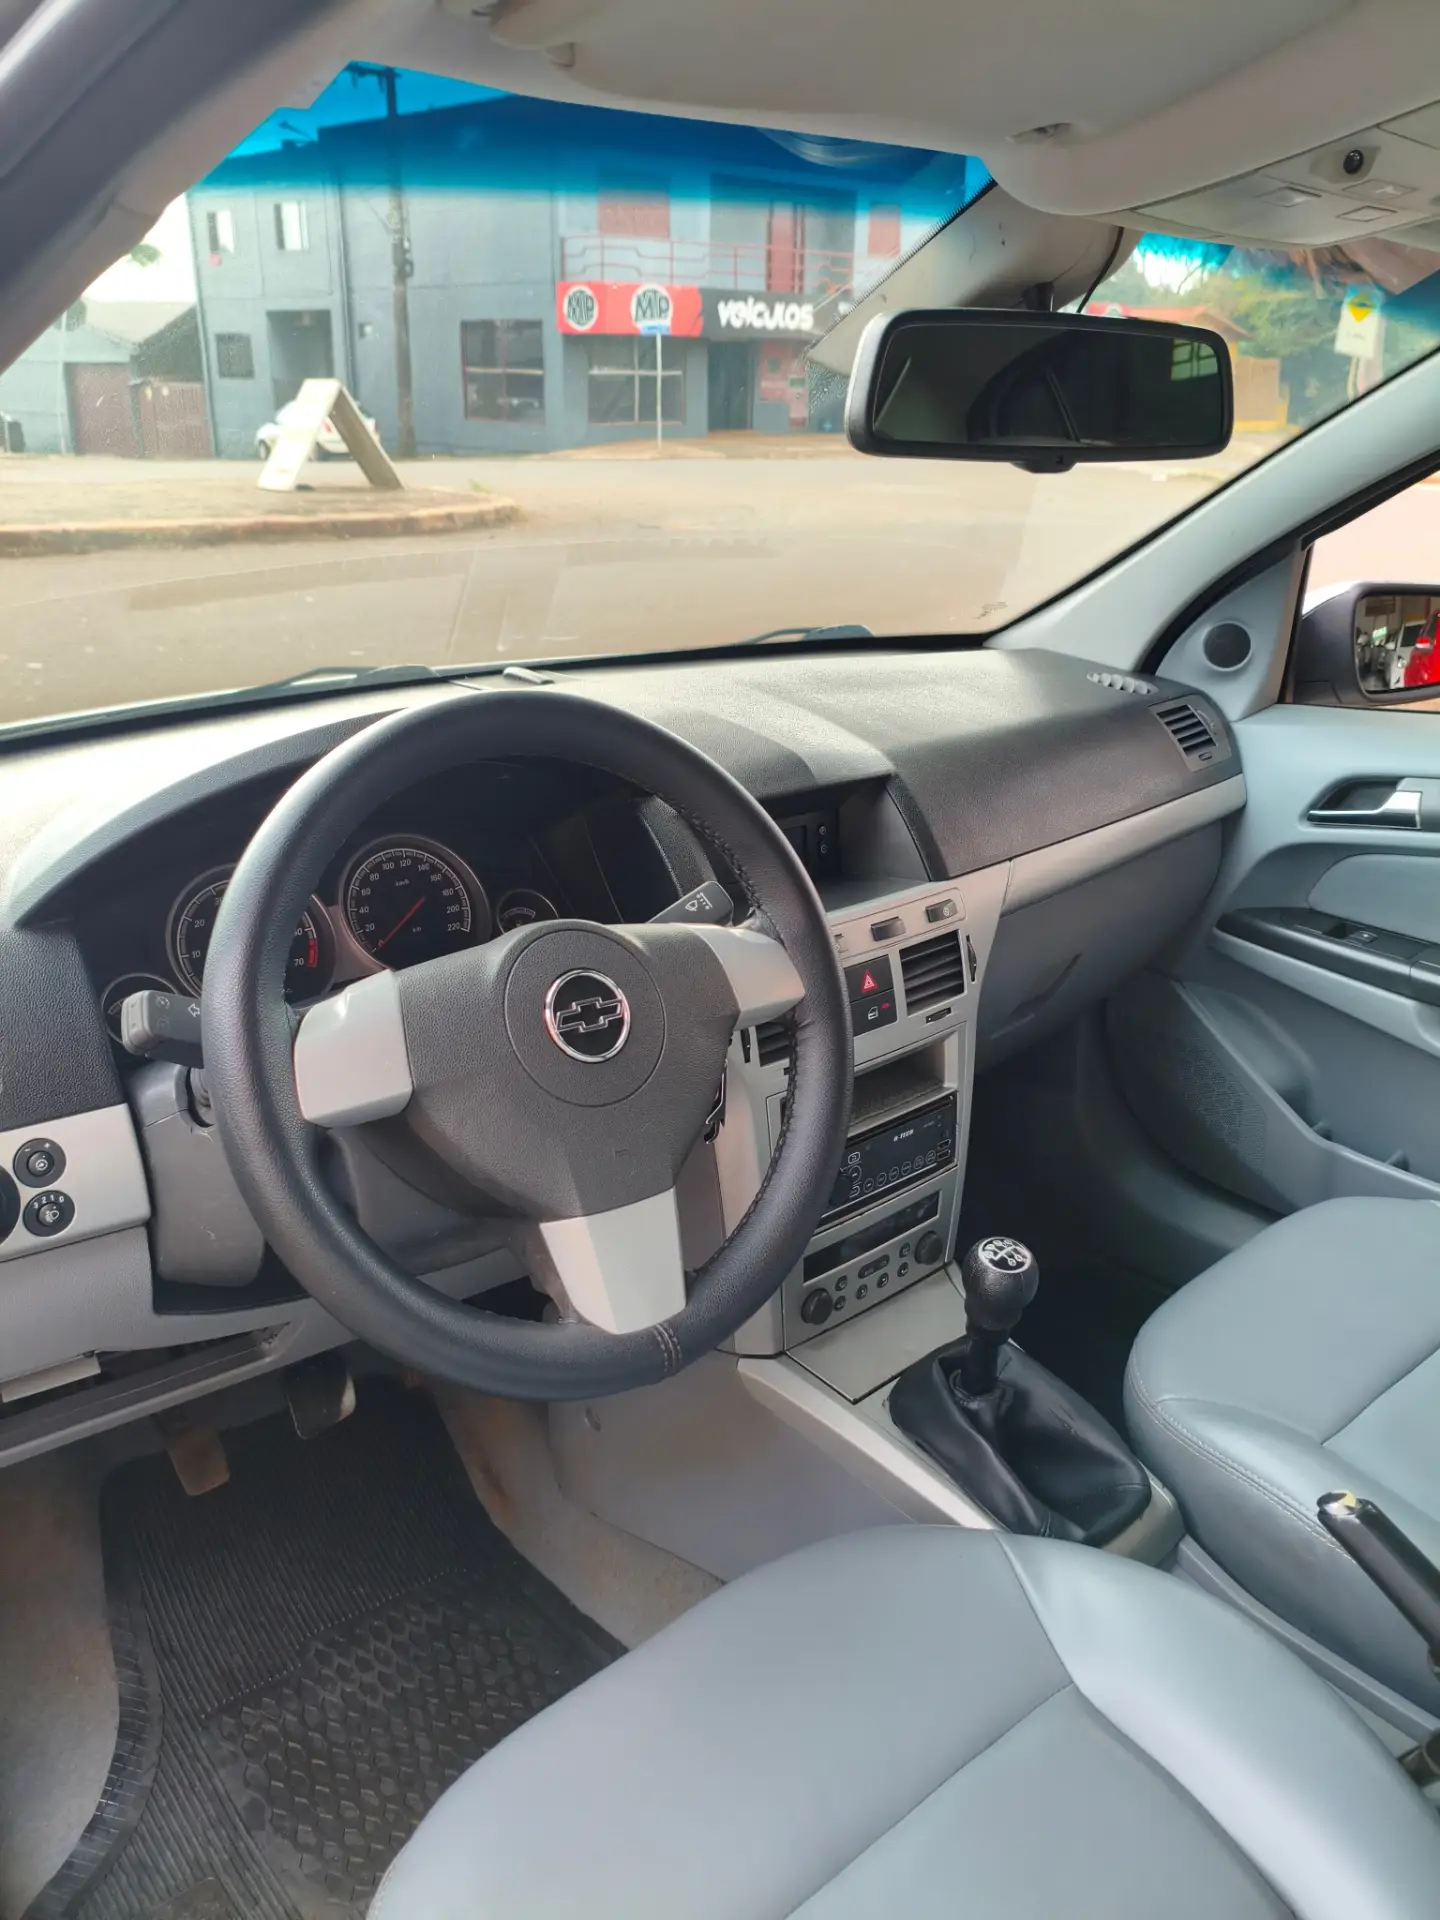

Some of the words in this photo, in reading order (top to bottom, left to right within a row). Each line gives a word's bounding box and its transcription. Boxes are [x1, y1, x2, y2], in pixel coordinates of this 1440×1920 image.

[382, 862, 395, 871] 100
[400, 859, 412, 867] 120
[418, 863, 430, 872] 140
[369, 873, 380, 881] 80
[430, 873, 442, 882] 160
[359, 906, 369, 914] 40
[446, 904, 460, 914] 200
[194, 919, 205, 928] 20
[365, 923, 375, 931] 20
[447, 922, 461, 931] 220
[192, 950, 201, 959] 10
[294, 957, 304, 967] 70
